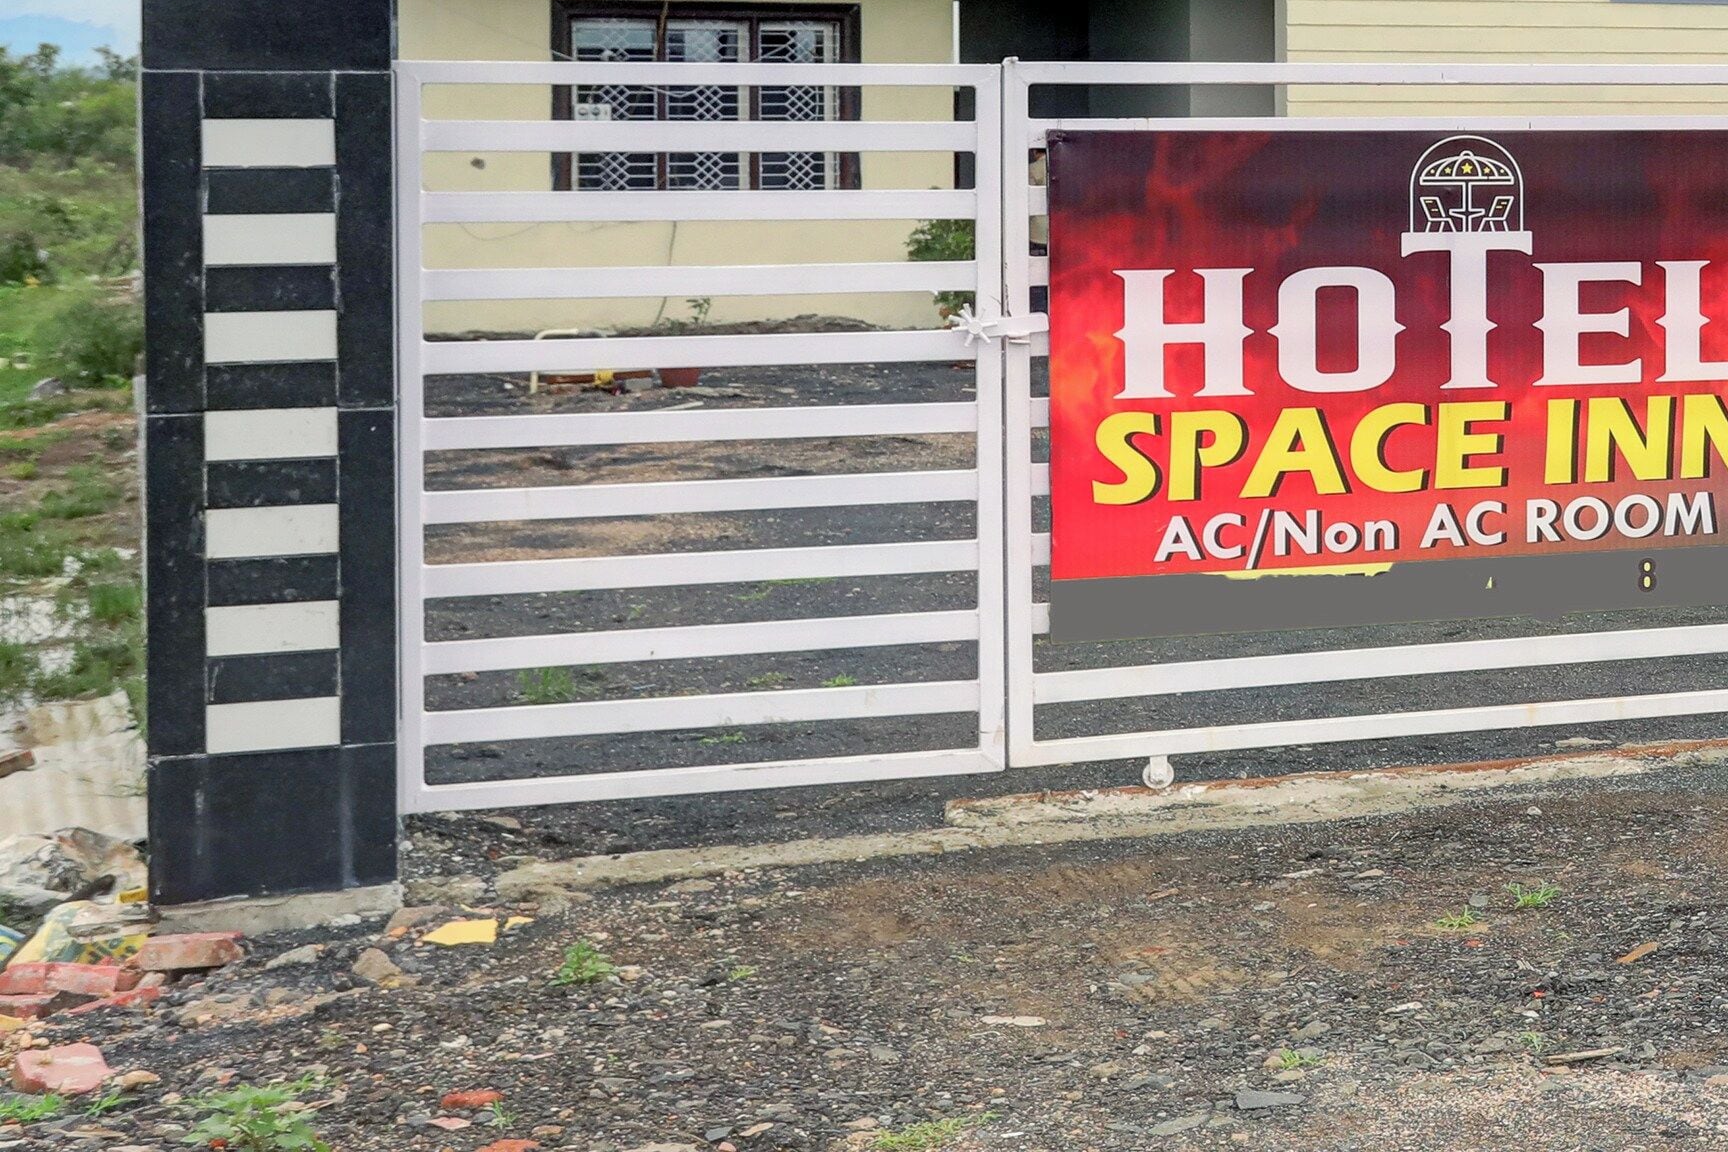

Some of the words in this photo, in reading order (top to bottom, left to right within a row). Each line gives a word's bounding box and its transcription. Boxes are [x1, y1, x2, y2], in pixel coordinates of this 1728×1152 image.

[1091, 400, 1508, 505] SPACE
[1152, 508, 1399, 570] AC/Non
[1419, 499, 1507, 550] AC
[1525, 490, 1718, 544] ROOM
